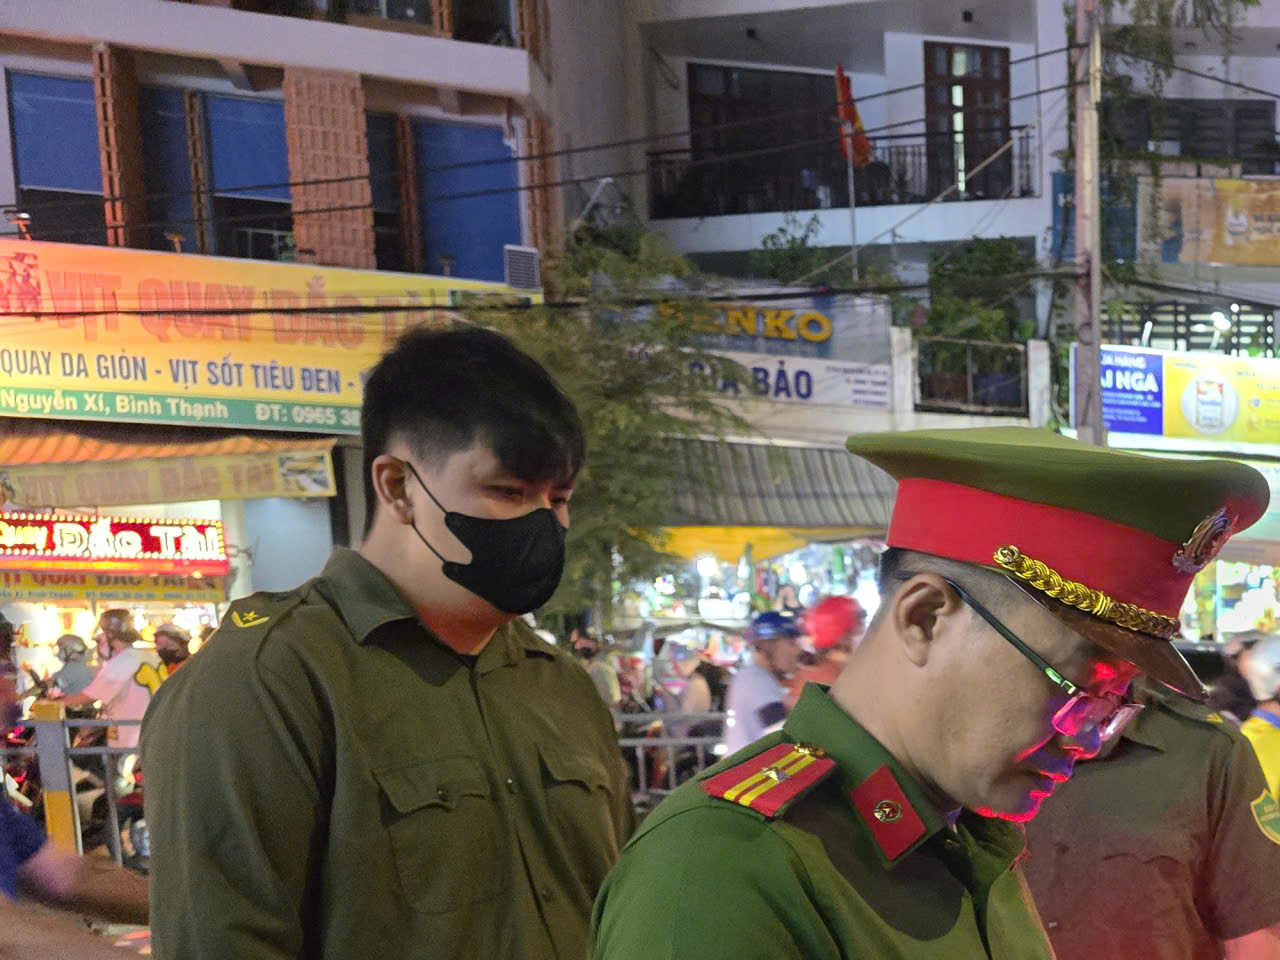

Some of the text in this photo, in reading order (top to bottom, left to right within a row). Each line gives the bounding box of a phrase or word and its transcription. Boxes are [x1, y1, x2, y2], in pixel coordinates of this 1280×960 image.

[1, 348, 51, 376] QUAY
[61, 352, 89, 377] DA
[169, 358, 199, 391] VỊT
[207, 352, 244, 387] SỐT
[250, 359, 294, 390] TIÊU
[301, 366, 341, 394] ĐEN
[1115, 369, 1159, 393] NGA
[0, 388, 78, 414] Nguyễn
[116, 395, 162, 416] Bình
[166, 397, 229, 420] Thạnh
